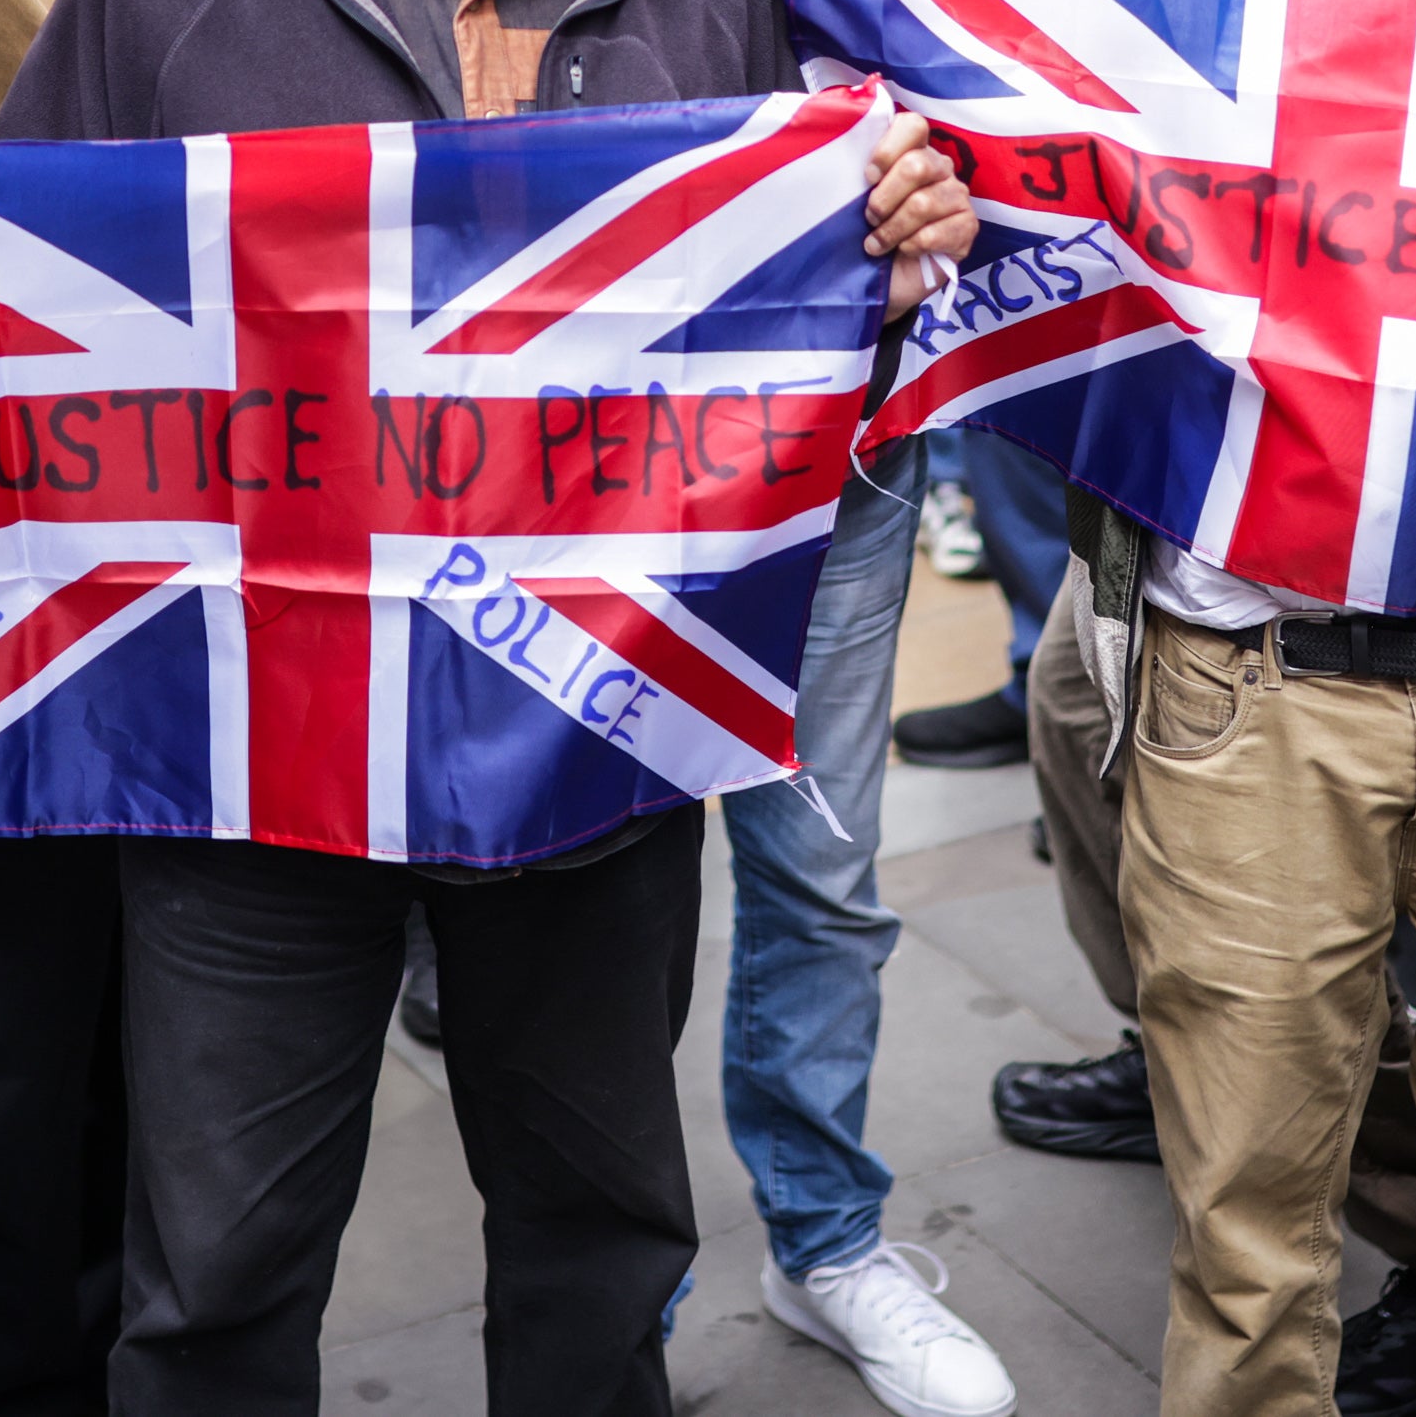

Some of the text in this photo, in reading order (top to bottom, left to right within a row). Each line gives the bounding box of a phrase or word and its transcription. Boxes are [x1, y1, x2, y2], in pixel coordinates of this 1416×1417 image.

[905, 220, 1125, 356] RACIST
[371, 389, 486, 499] NO
[537, 376, 833, 504] PEACE
[419, 543, 659, 746] POLICE
